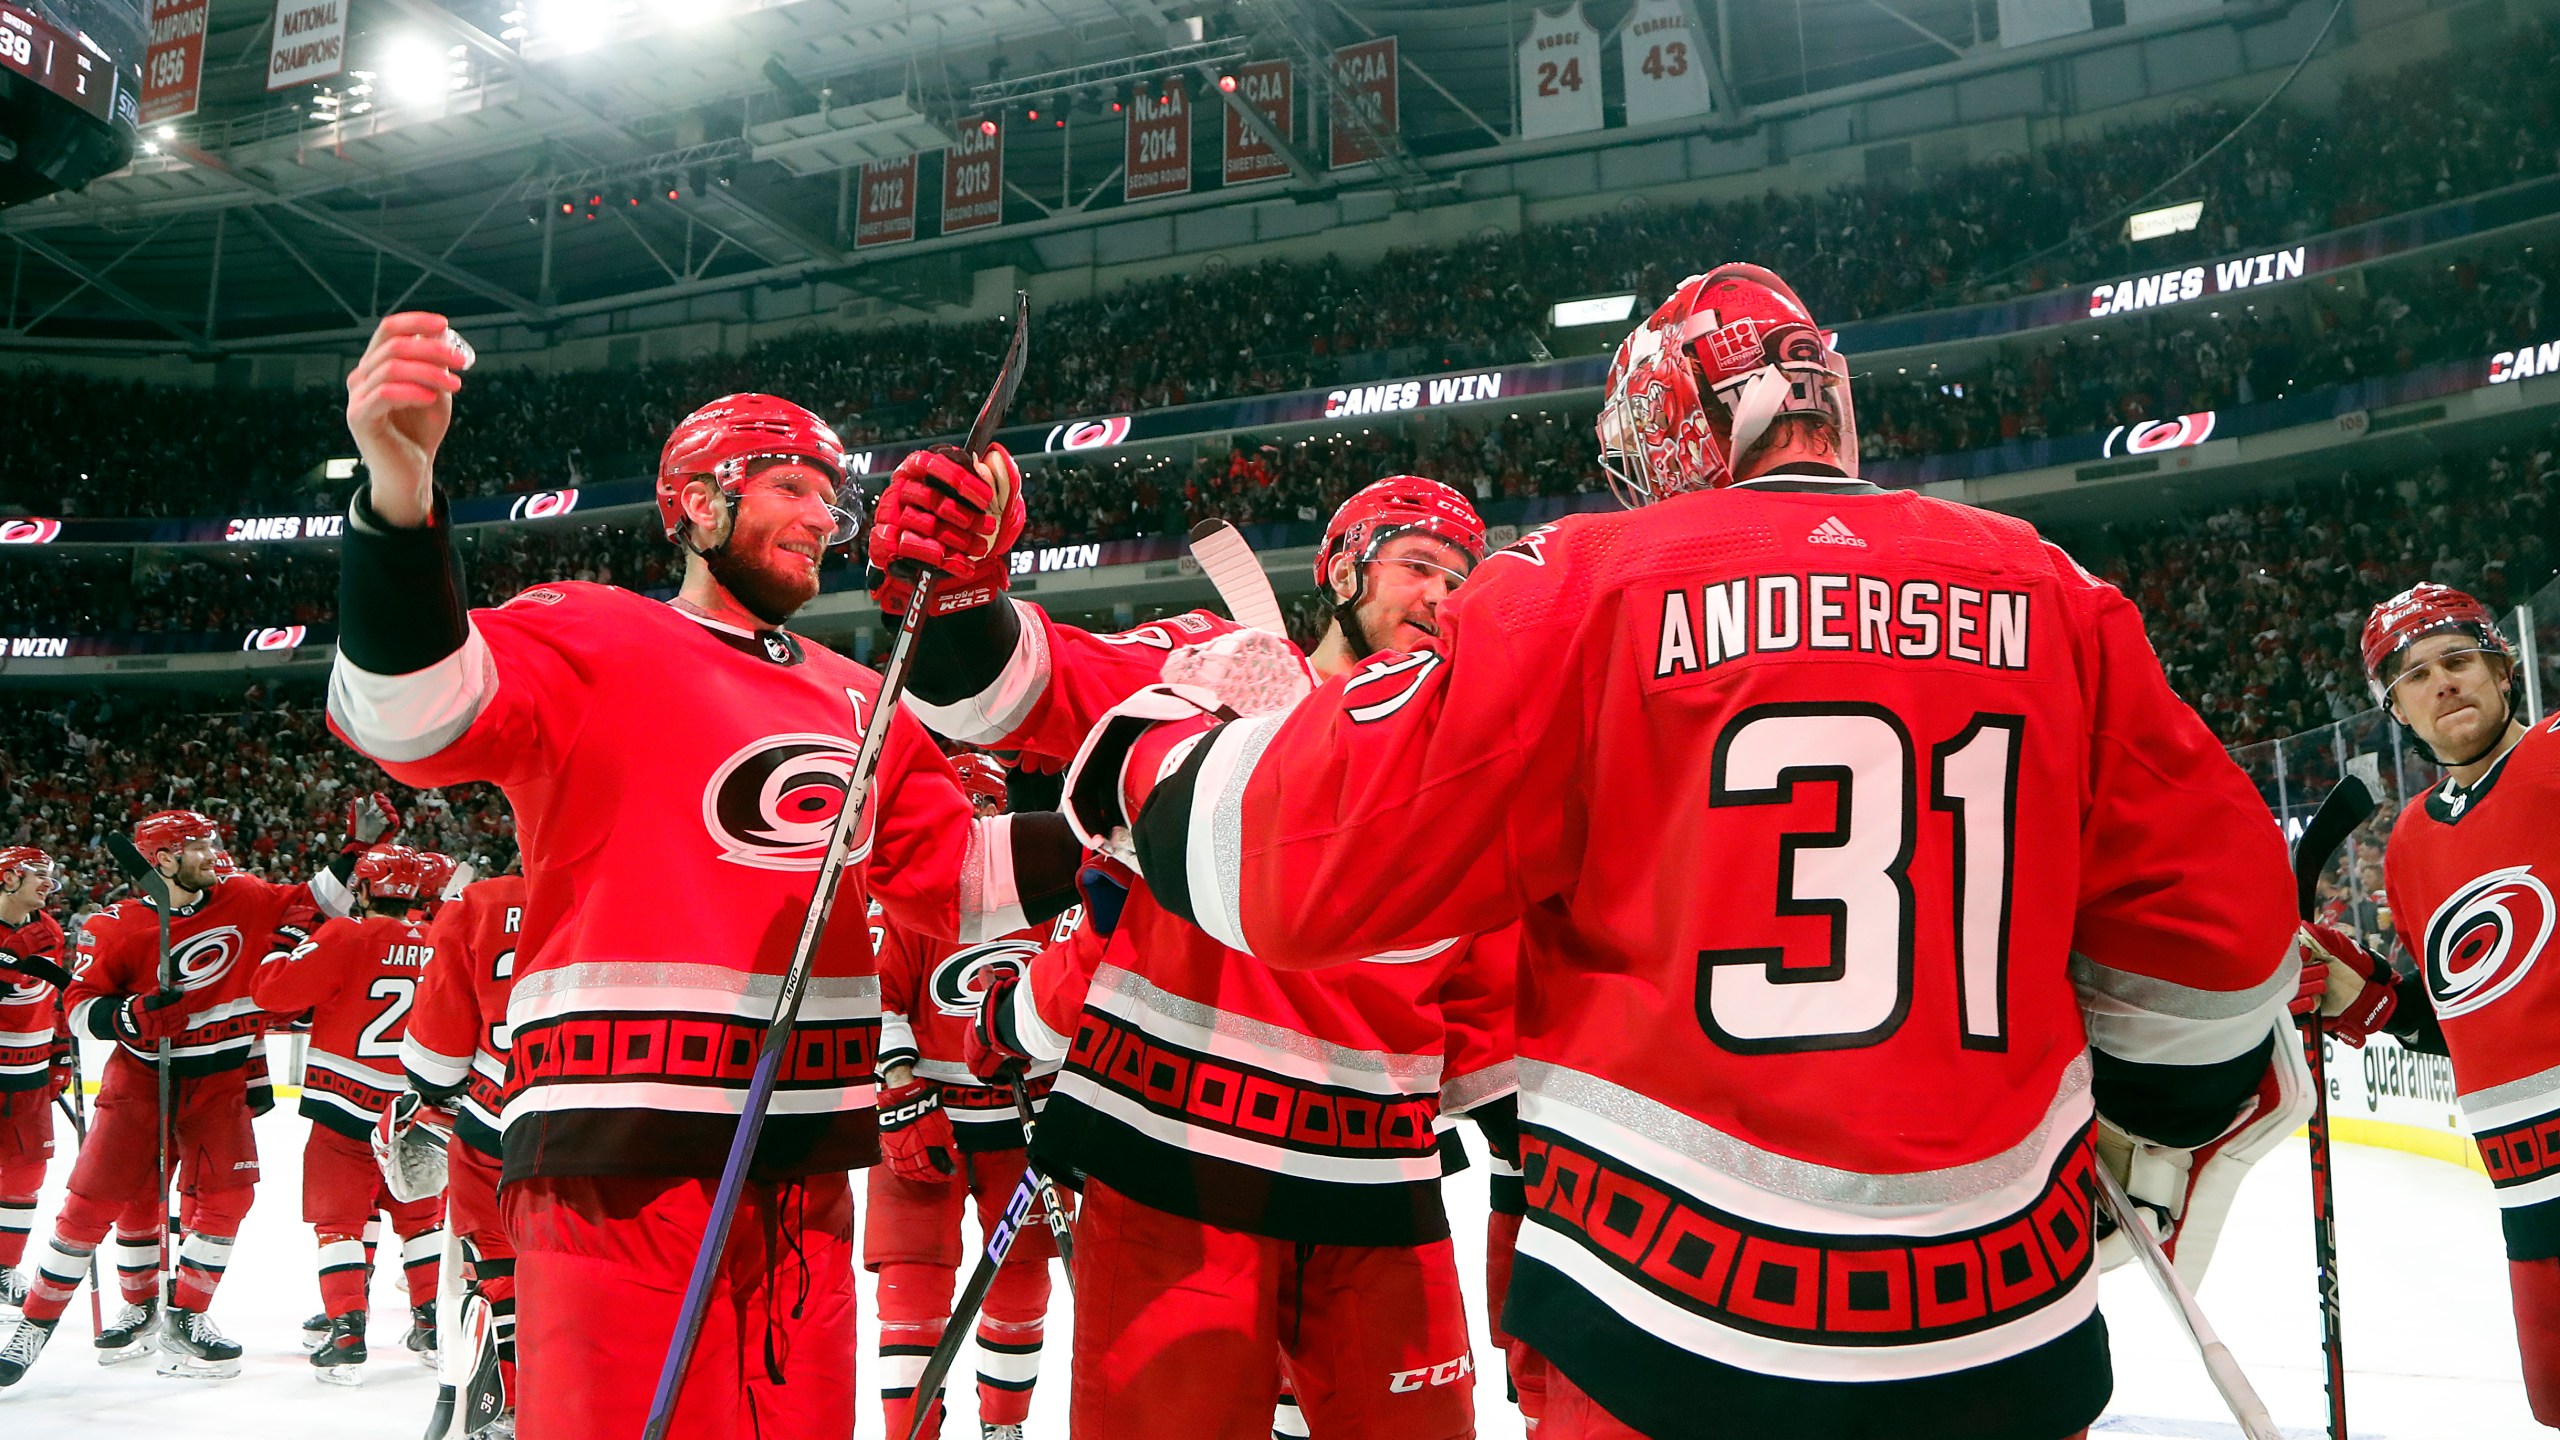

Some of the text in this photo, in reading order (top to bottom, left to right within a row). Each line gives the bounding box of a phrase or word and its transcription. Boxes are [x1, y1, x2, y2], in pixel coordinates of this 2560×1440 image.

[3, 11, 33, 36] SHOTS
[150, 8, 204, 44] HAMPIONS
[282, 2, 338, 37] NATIONAL
[0, 26, 33, 66] 39
[273, 36, 341, 74] CHAMPIONS
[1641, 41, 1688, 80] 43
[76, 74, 86, 95] 1
[150, 47, 185, 88] 1956
[1537, 56, 1583, 97] 24
[1139, 126, 1178, 163] 2014
[869, 177, 905, 213] 2012
[955, 160, 991, 197] 2013
[2089, 246, 2305, 318] CANES WIN
[1719, 347, 1762, 368] HERNING
[1325, 372, 1502, 418] CANES WIN
[225, 515, 344, 542] CANES WI
[1437, 500, 1477, 525] CCM
[1039, 543, 1101, 572] WIN
[1807, 534, 1868, 548] adidas
[906, 570, 932, 628] CCM
[939, 593, 990, 611] CCM
[1655, 574, 2031, 679] ANDERSEN
[12, 638, 68, 657] WIN
[396, 883, 411, 895] 24
[1693, 701, 2026, 1055] 31
[878, 1092, 938, 1127] CCM
[1389, 1350, 1475, 1393] CCM
[481, 1392, 496, 1414] 32
